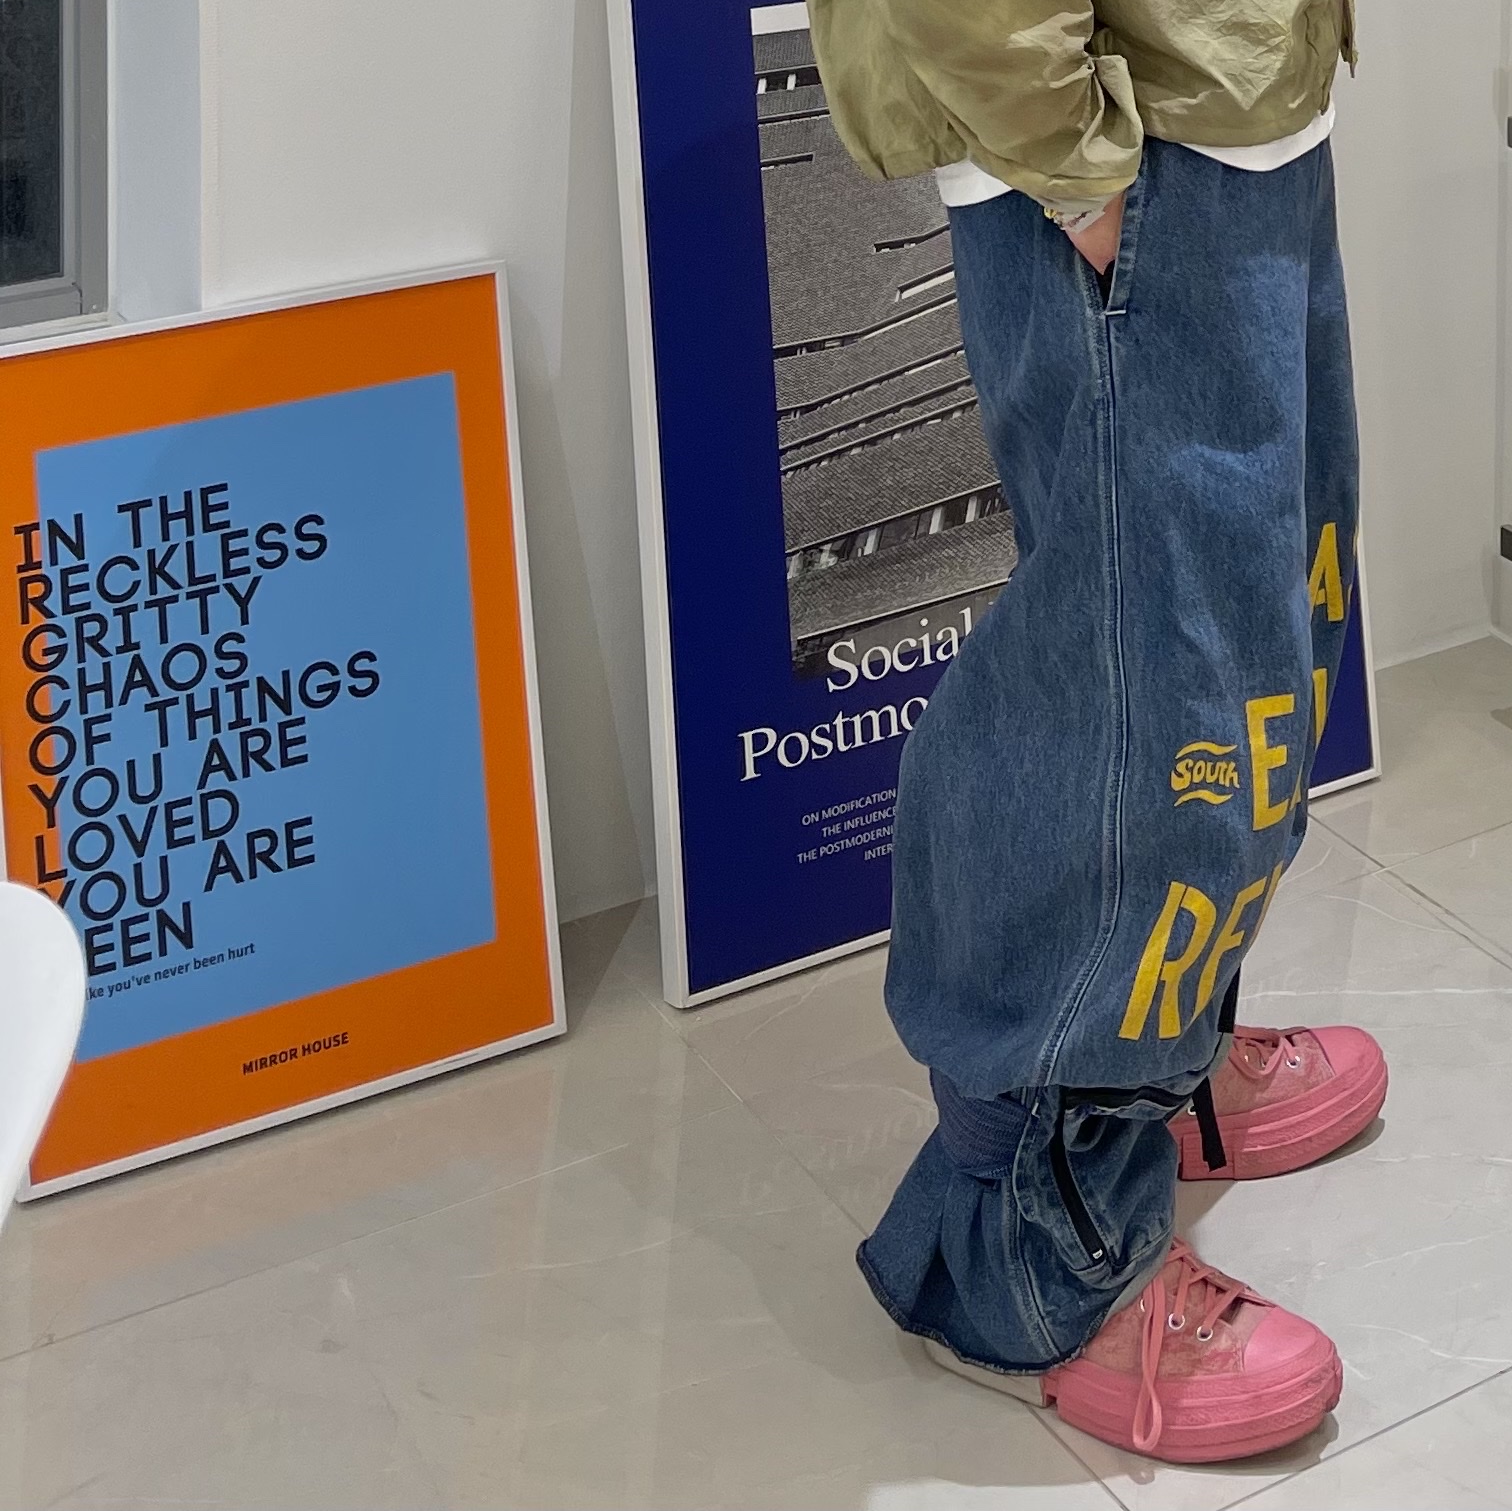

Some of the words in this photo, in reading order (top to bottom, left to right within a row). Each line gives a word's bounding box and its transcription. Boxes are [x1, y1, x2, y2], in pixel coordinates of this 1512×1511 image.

[14, 513, 85, 573] IN
[117, 483, 231, 548] THE
[19, 514, 328, 625] RECKLESS
[22, 575, 263, 673] GRITTY
[826, 607, 972, 693] Social
[26, 632, 248, 724] CHAOS
[29, 713, 112, 775] OF
[144, 650, 380, 748] THINGS
[28, 752, 163, 829] YOU
[197, 716, 309, 790] ARE
[737, 696, 928, 782] Postmo
[35, 788, 240, 884] LOVED
[203, 816, 315, 892] ARE
[797, 848, 818, 864] THE
[820, 824, 893, 857] POSTMODERNI
[802, 811, 819, 826] ON
[822, 823, 841, 838] THE
[864, 843, 895, 861] INTER
[85, 901, 194, 977] EEN
[108, 975, 150, 998] you've
[154, 963, 191, 982] never
[194, 952, 225, 970] been
[228, 943, 256, 961] hurt
[242, 1048, 298, 1076] MIRROR
[302, 1031, 349, 1057] HOUSE
